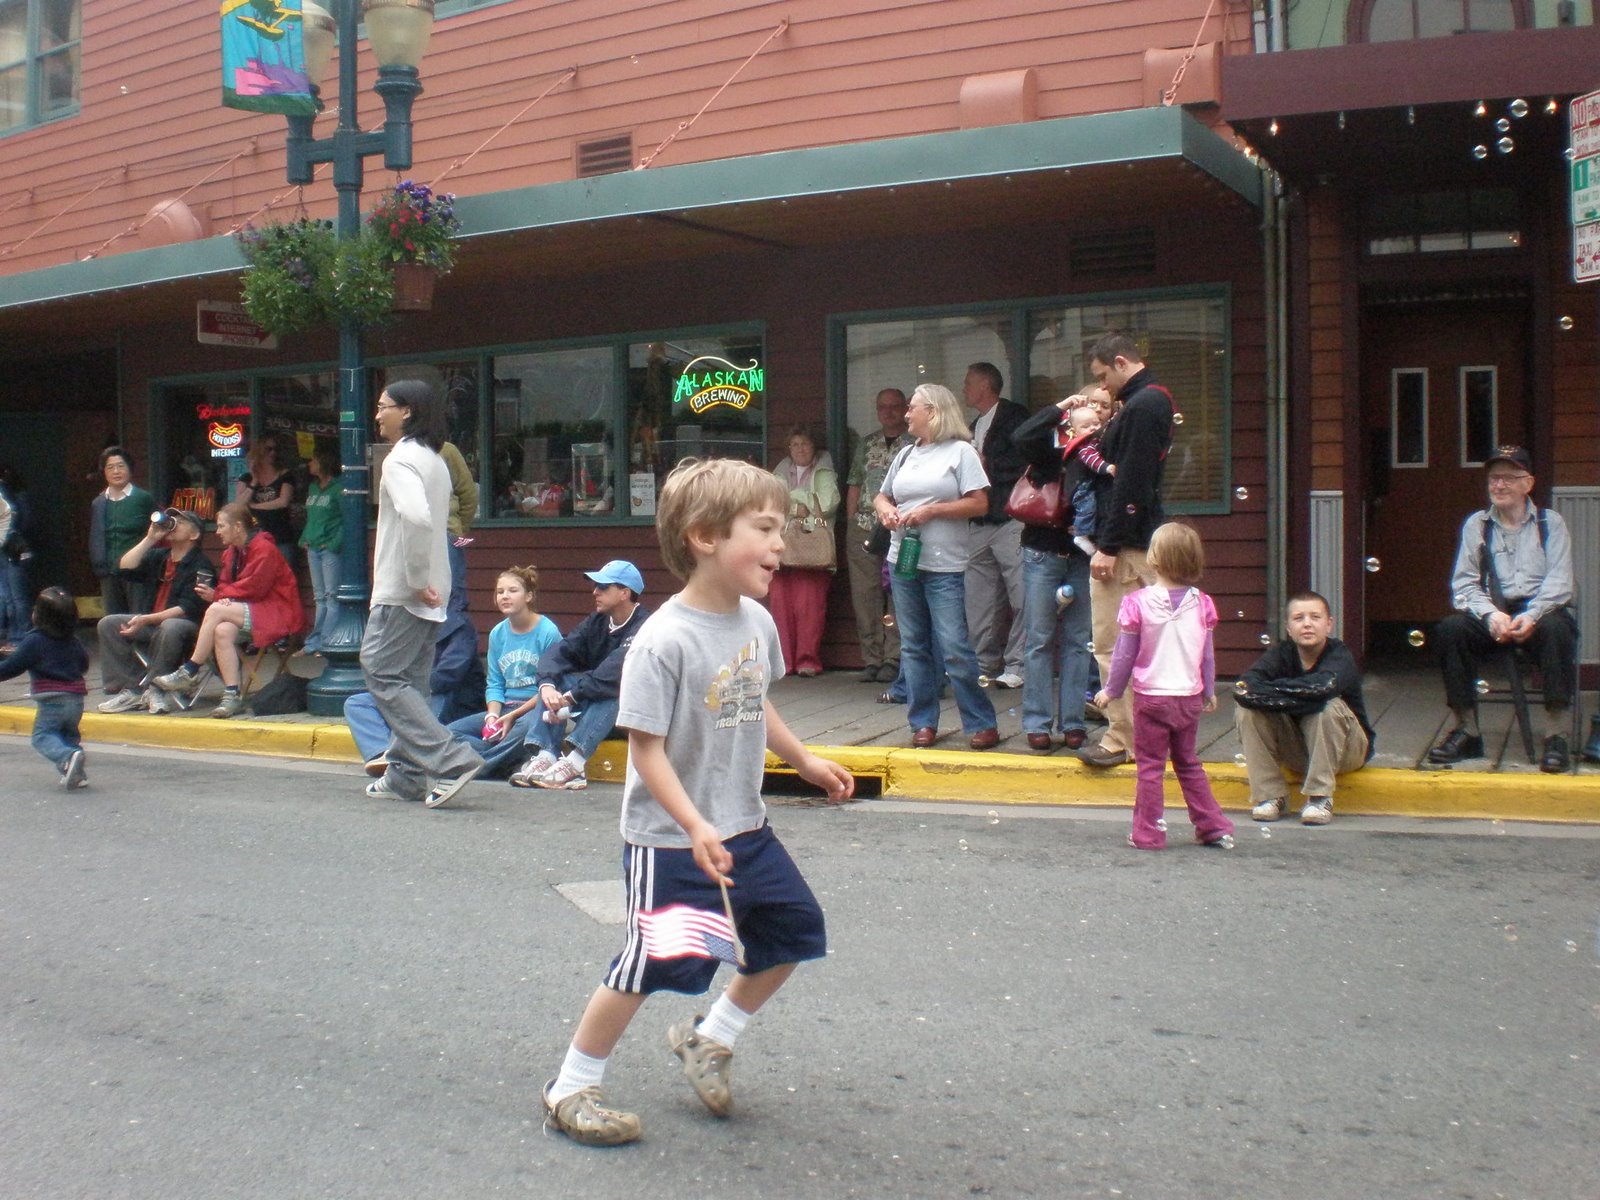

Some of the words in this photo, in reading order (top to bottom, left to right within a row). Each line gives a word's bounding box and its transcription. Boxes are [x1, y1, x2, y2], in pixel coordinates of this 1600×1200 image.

[1572, 102, 1586, 128] NO
[674, 369, 764, 402] ALASKAN
[694, 388, 746, 408] BREWING
[212, 432, 223, 445] HOT
[211, 447, 241, 457] INTERNET
[171, 487, 215, 520] ATM
